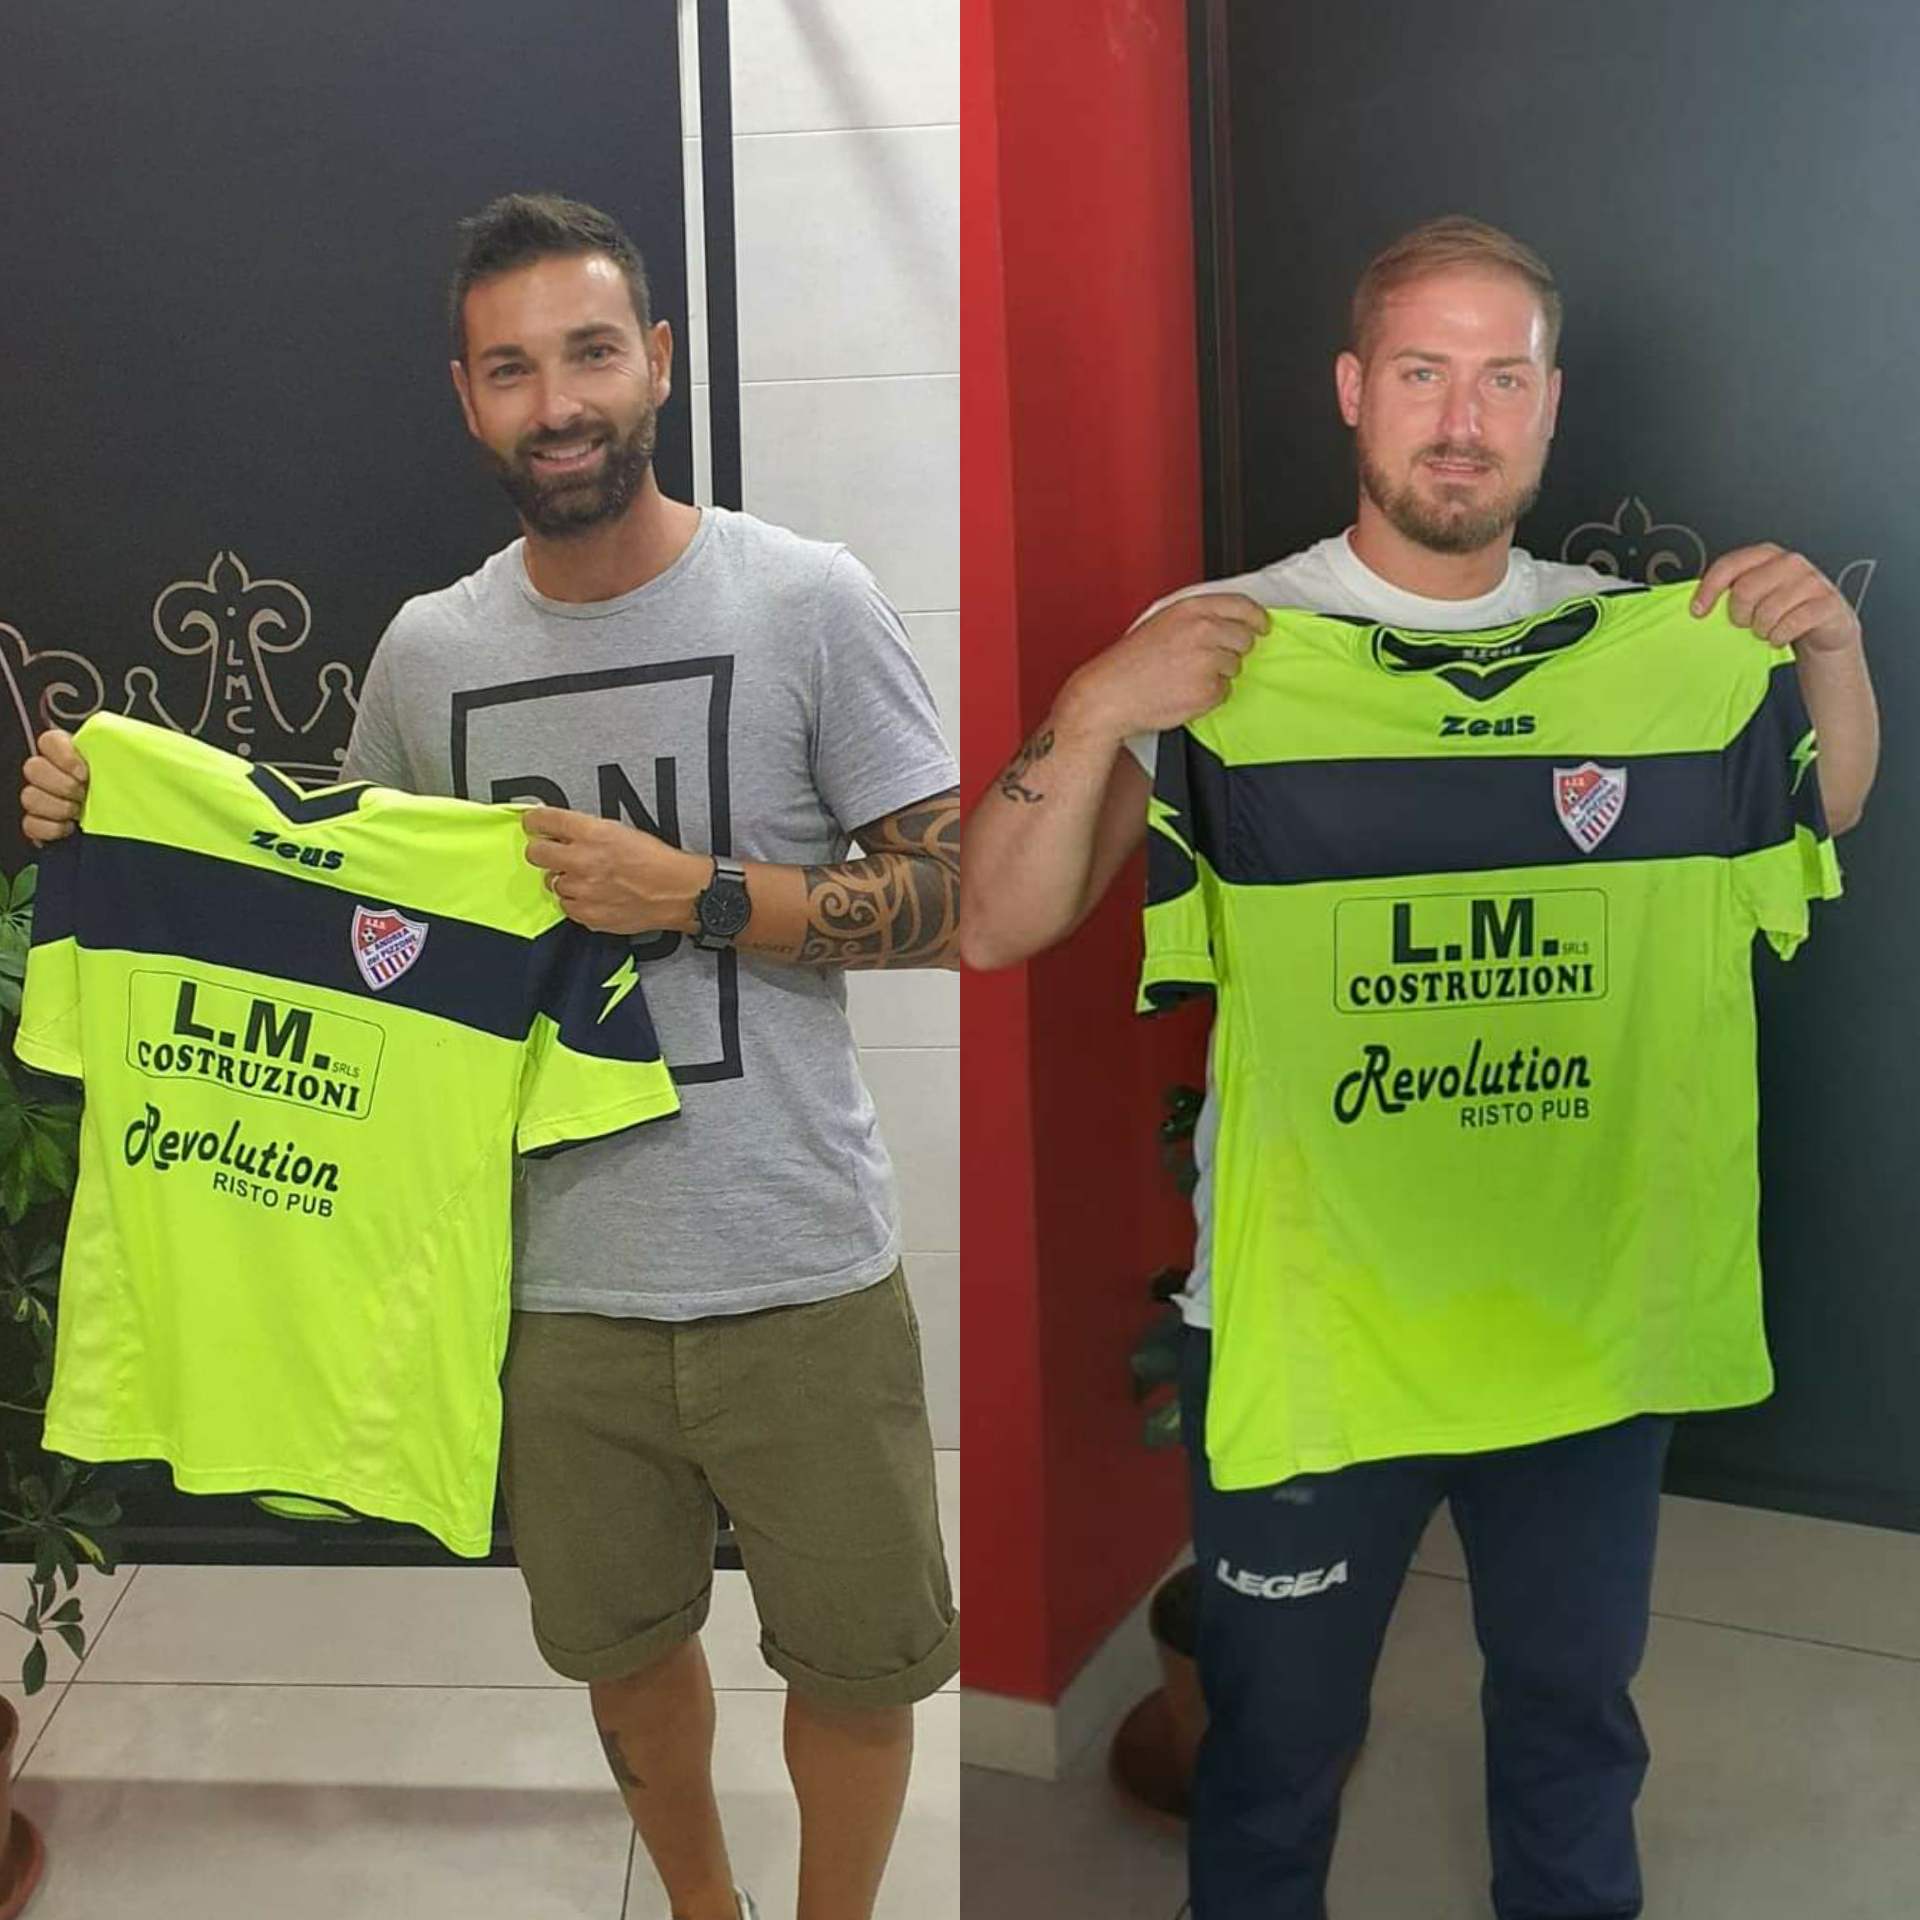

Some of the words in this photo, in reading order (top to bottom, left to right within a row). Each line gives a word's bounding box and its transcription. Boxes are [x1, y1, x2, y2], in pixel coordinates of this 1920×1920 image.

[1349, 963, 1594, 1006] COSTRUZIONI
[137, 1040, 360, 1112] COSTRUZIONI
[332, 1061, 360, 1079] SRLS
[1333, 1038, 1591, 1125] Revolution
[1461, 1102, 1534, 1128] RISTO
[1542, 1098, 1590, 1121] PUB
[124, 1101, 339, 1192] Revolution
[212, 1171, 278, 1208] RISTO
[286, 1193, 334, 1218] PUB
[1216, 1557, 1348, 1600] LEGEA
